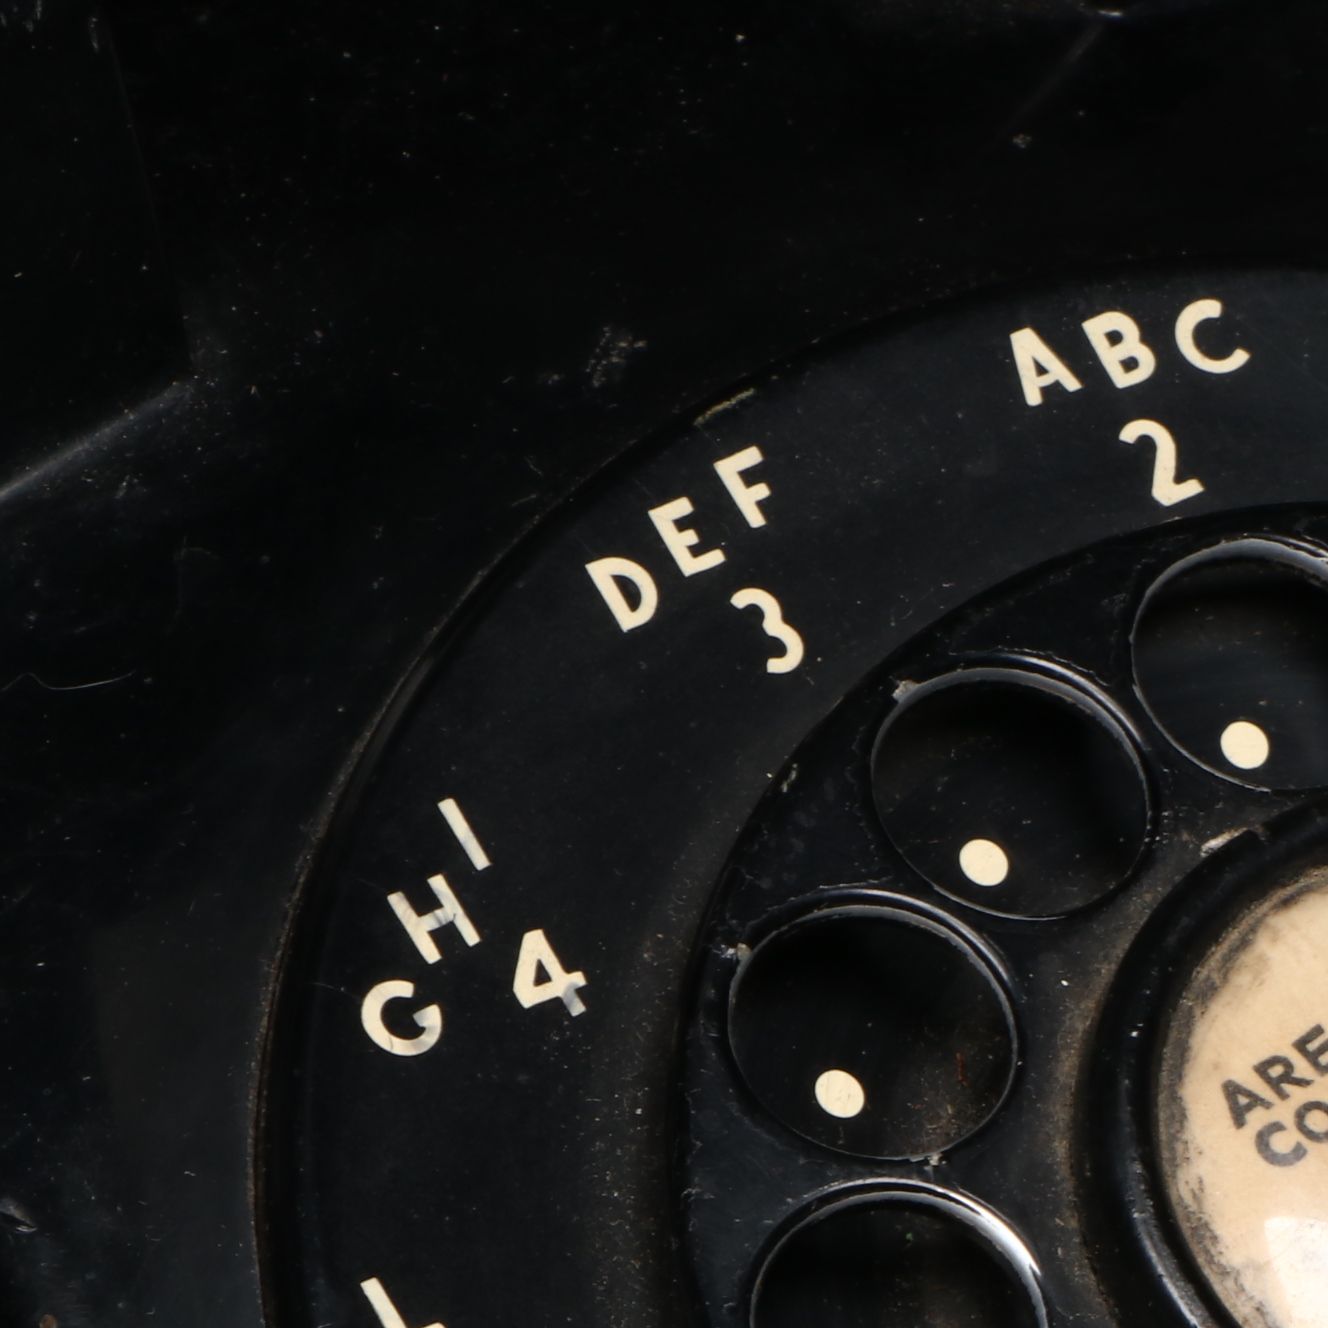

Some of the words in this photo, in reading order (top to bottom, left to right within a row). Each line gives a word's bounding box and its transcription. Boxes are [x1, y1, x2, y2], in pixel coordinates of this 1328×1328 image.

[1011, 301, 1250, 405] ABC
[1120, 421, 1203, 506] 2
[586, 448, 773, 633] DEF
[731, 589, 803, 673] 3
[514, 930, 587, 1016] 4
